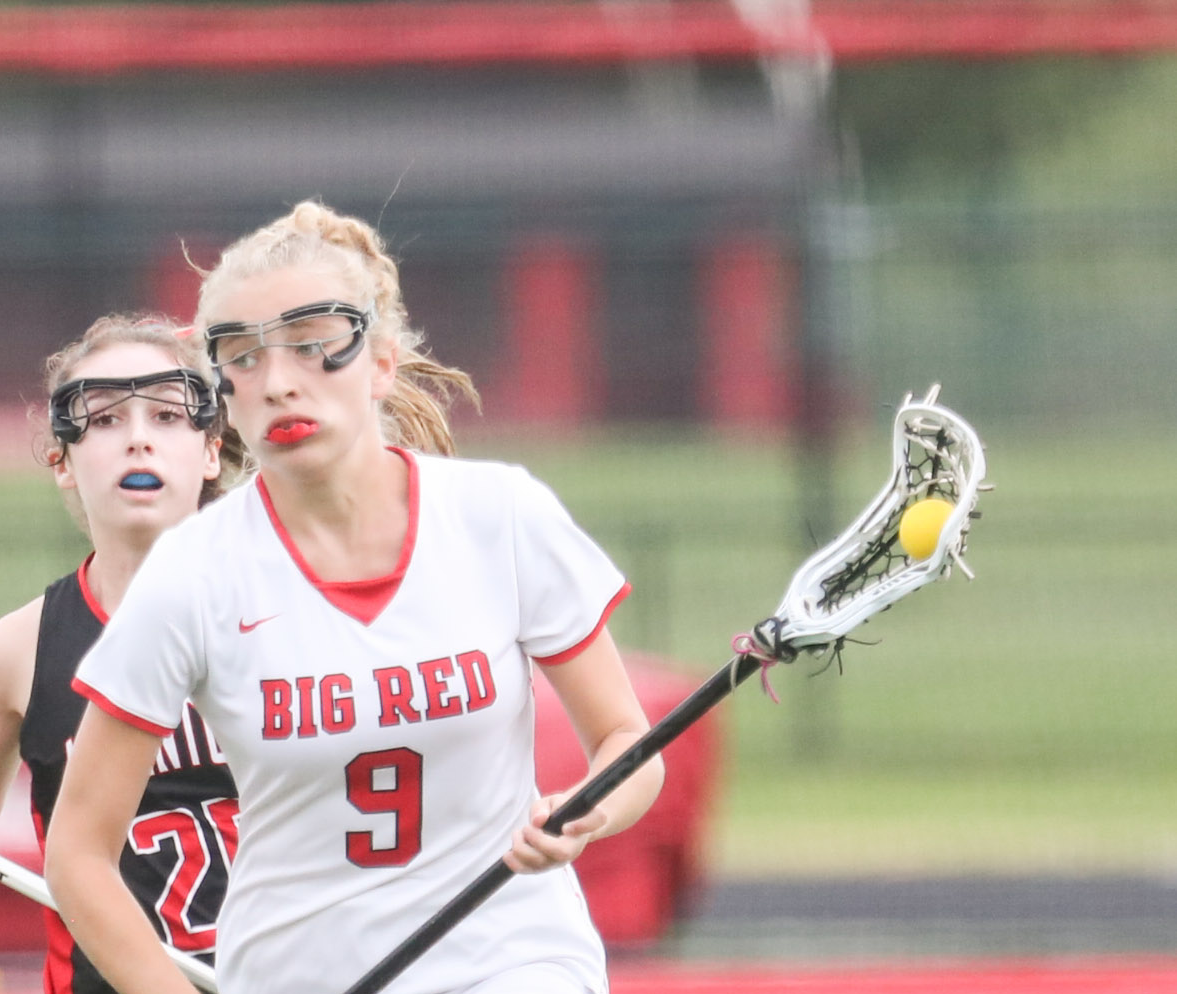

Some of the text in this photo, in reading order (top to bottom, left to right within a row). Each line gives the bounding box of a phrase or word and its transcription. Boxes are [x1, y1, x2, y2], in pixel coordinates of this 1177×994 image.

[260, 673, 356, 740] BIG
[373, 649, 497, 727] RED
[344, 746, 423, 868] 9
